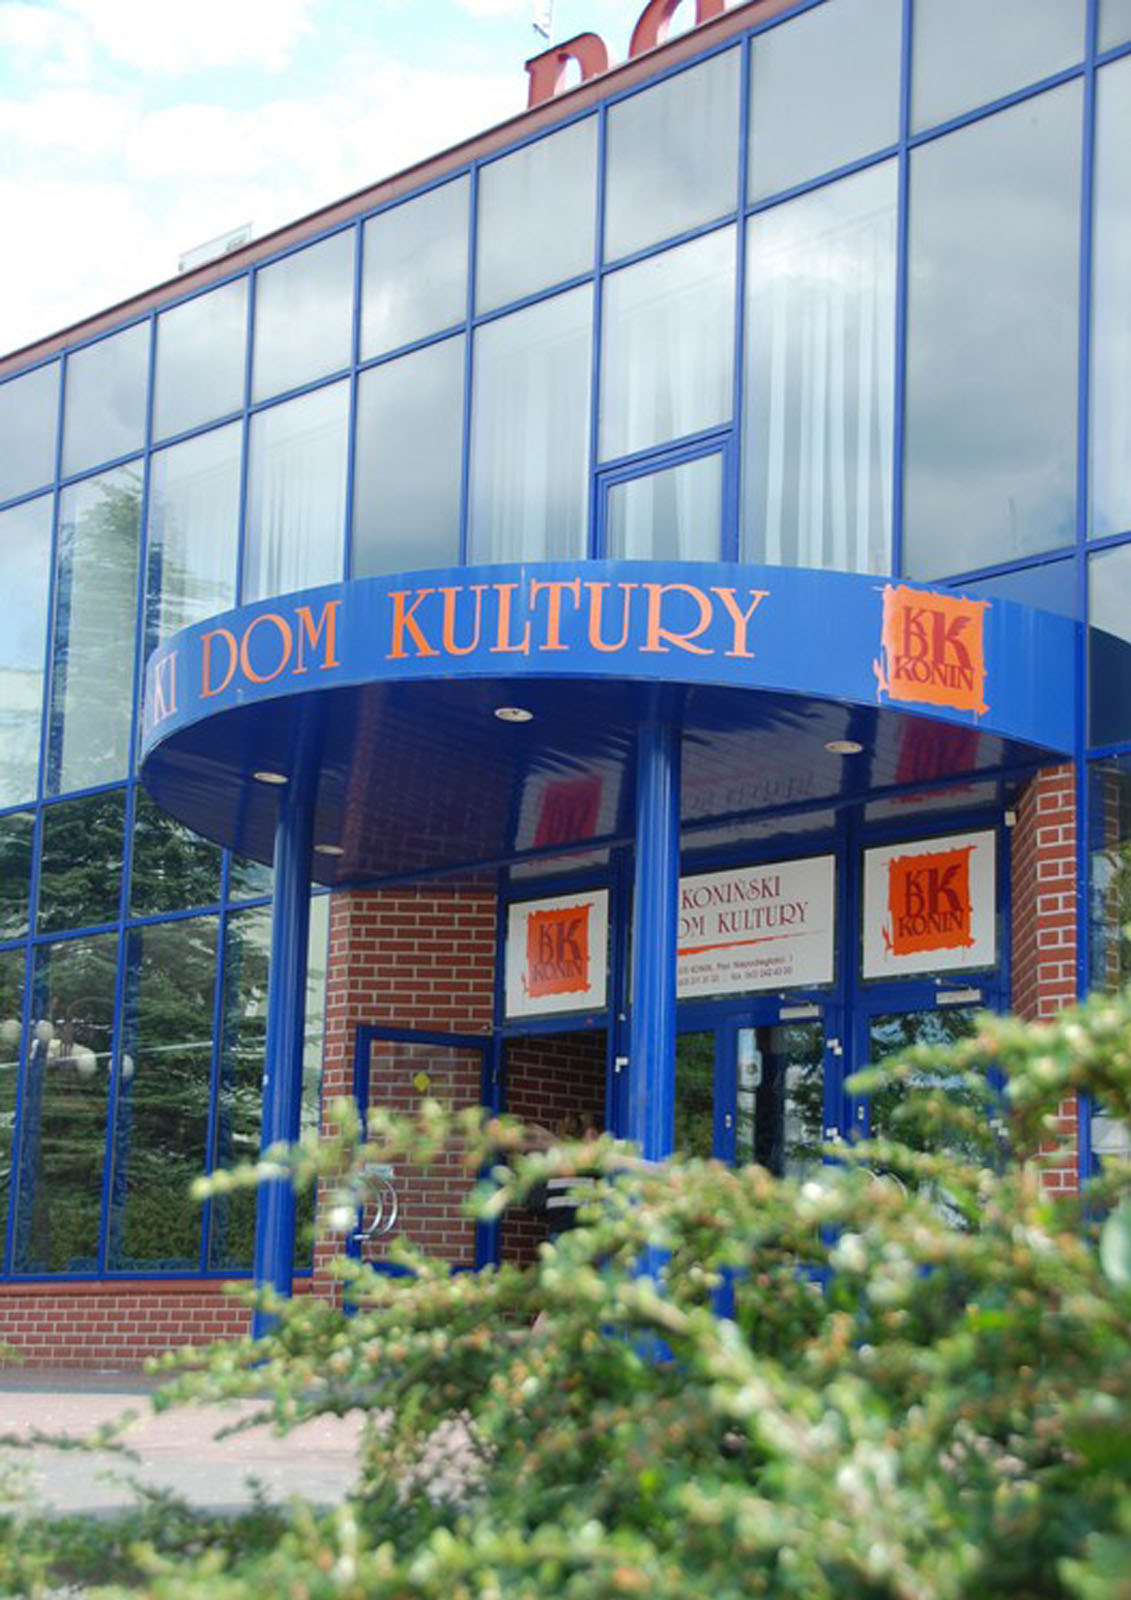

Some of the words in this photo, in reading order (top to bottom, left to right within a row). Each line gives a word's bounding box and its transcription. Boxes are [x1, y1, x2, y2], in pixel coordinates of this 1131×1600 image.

[152, 650, 178, 725] KI
[200, 600, 343, 699] DOM
[385, 576, 771, 660] KULTURY
[894, 655, 974, 691] KONIN
[678, 914, 705, 937] OM
[718, 900, 809, 933] KULTURY
[898, 909, 963, 937] KONIN
